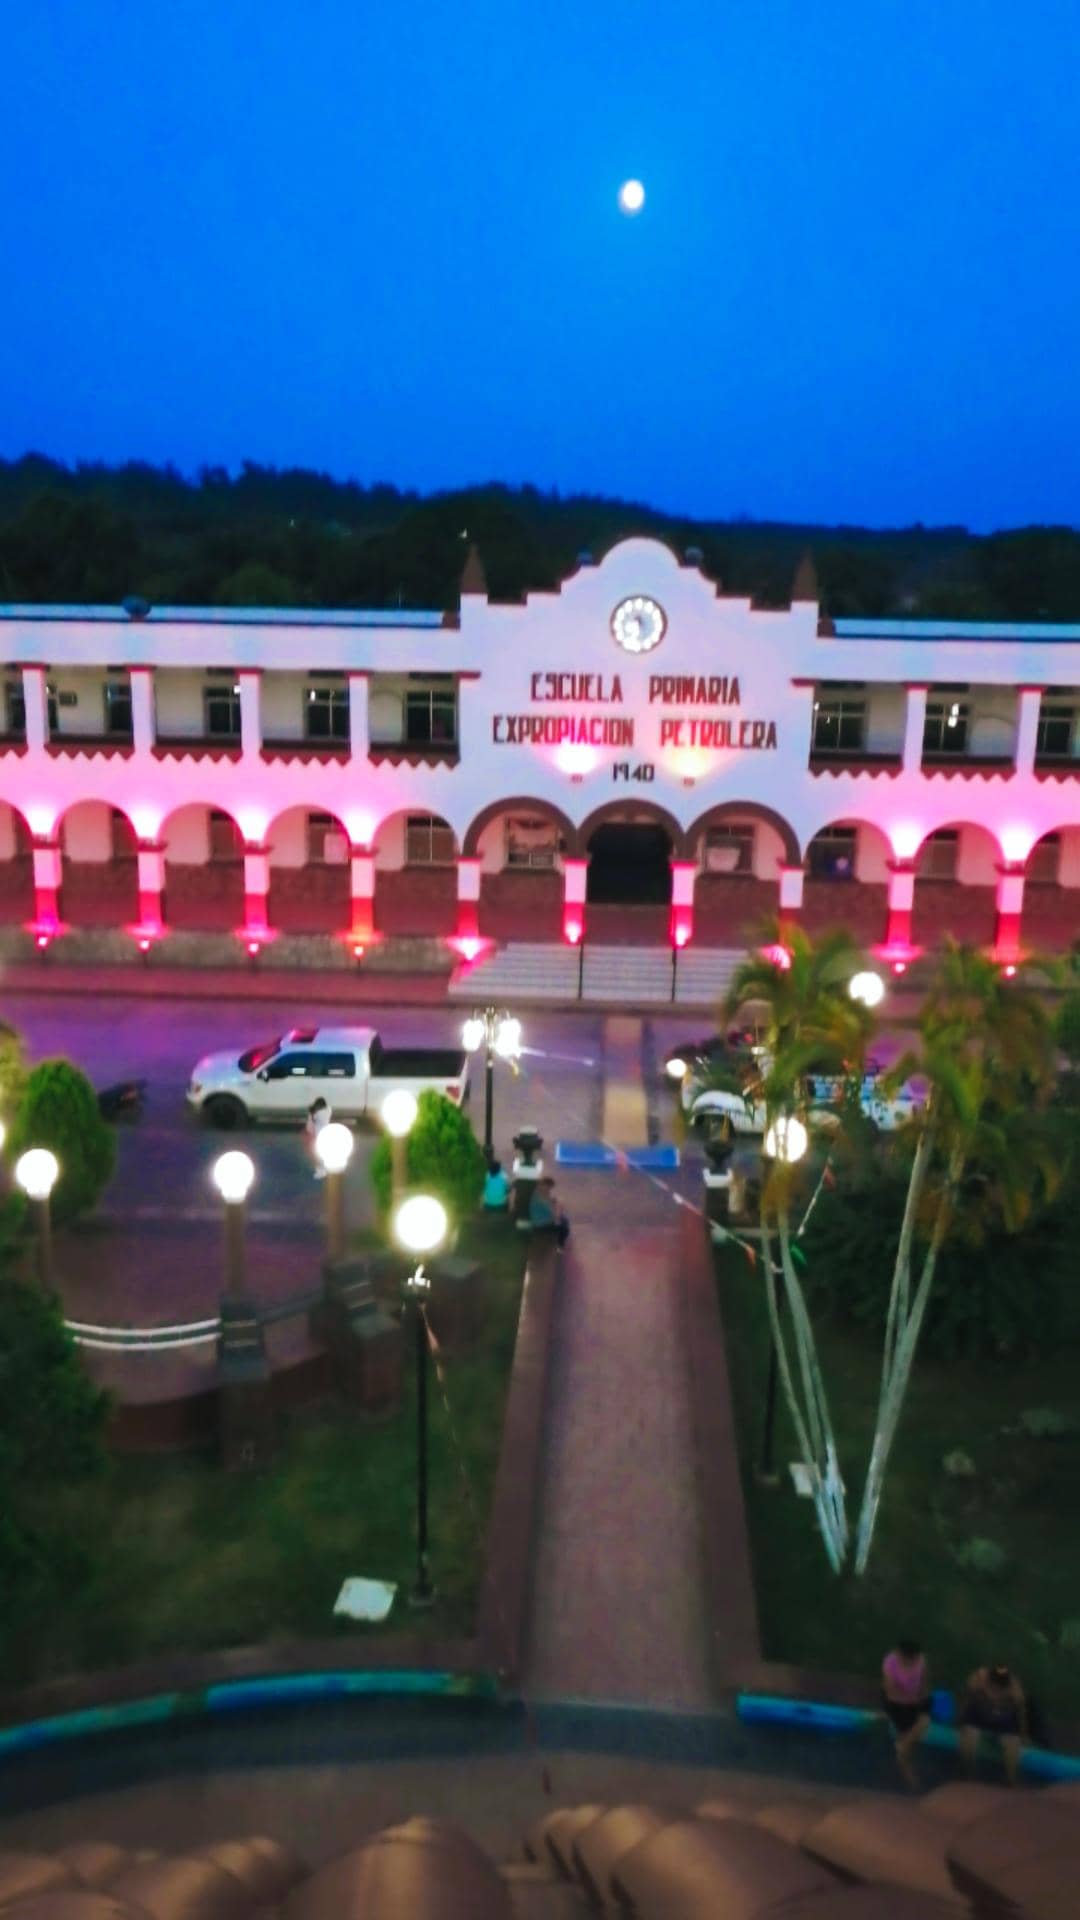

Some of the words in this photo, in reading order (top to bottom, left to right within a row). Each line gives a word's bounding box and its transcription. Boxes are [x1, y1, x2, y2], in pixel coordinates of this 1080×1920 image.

[531, 672, 623, 702] ESCUELA
[649, 674, 741, 705] PRIMARIA
[493, 715, 634, 746] EXPROPIACION
[660, 719, 777, 749] PETROLERA
[613, 763, 655, 782] 1940
